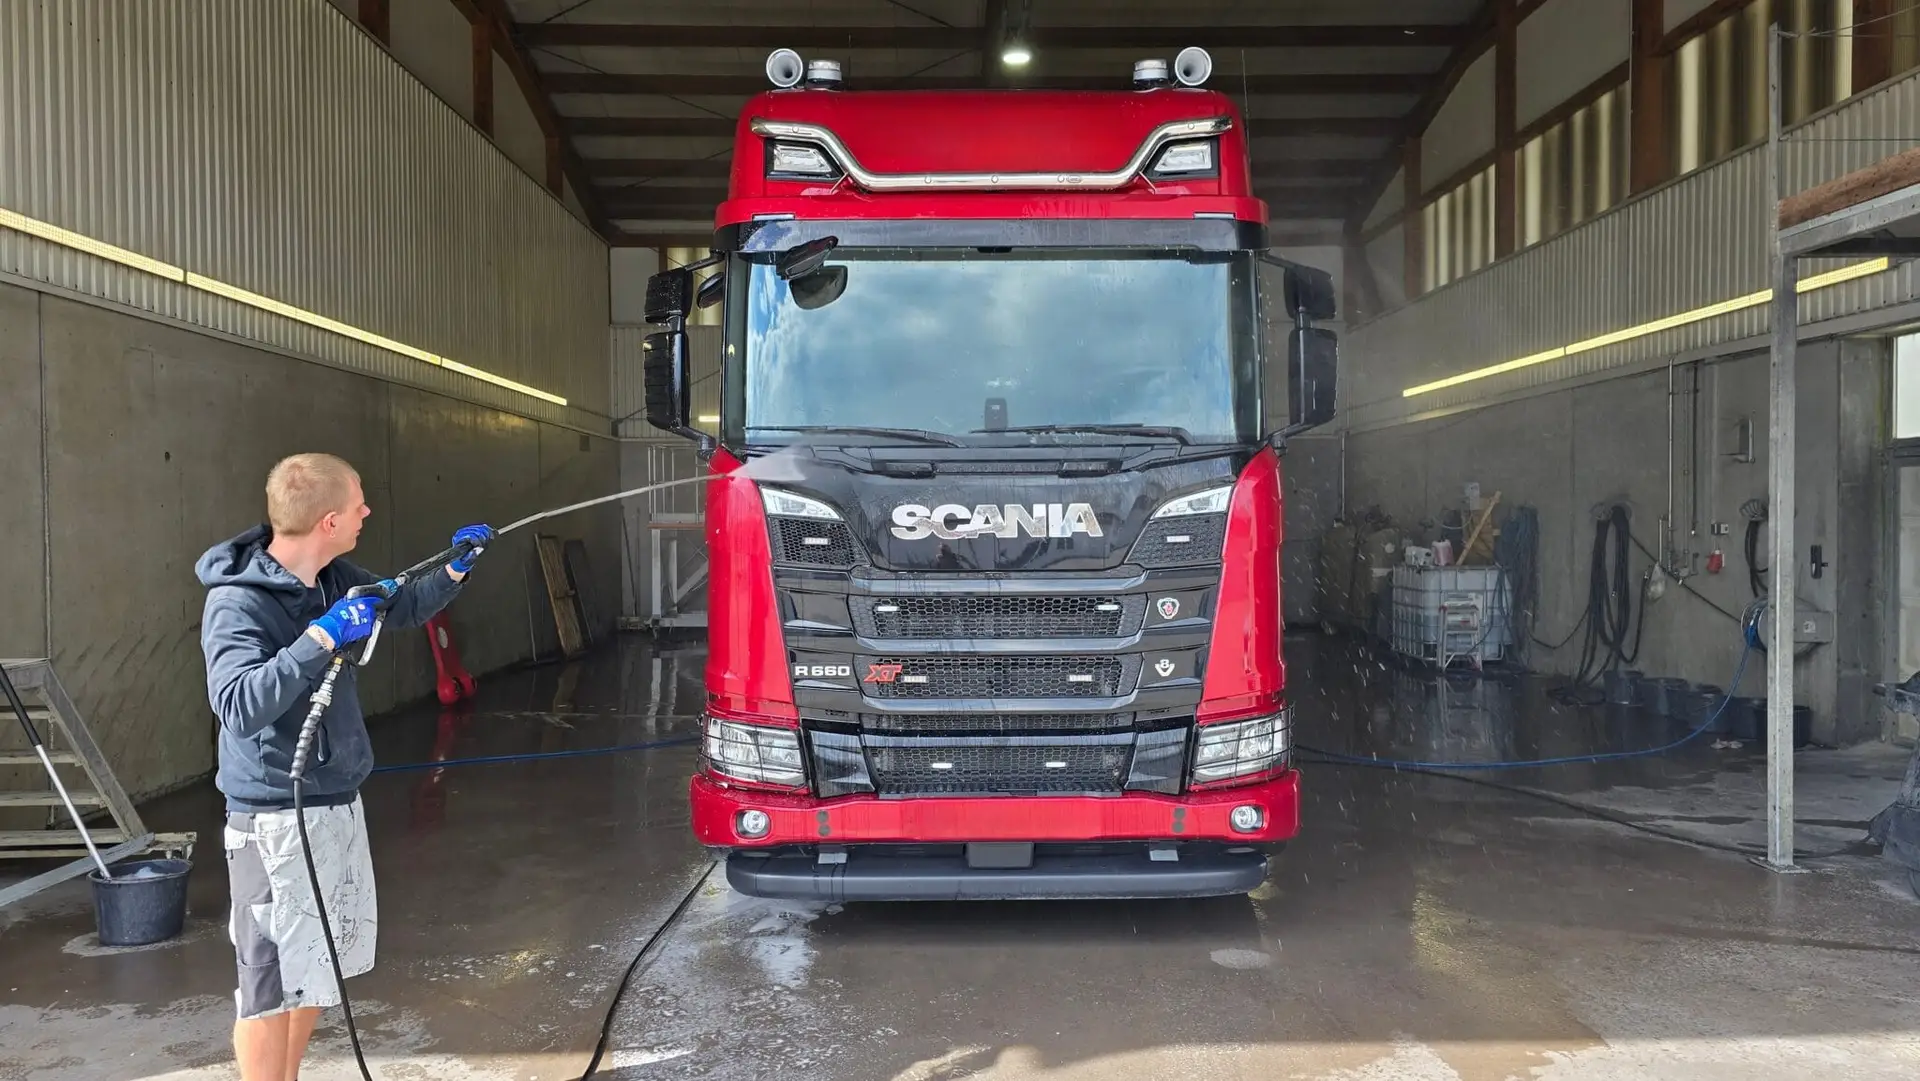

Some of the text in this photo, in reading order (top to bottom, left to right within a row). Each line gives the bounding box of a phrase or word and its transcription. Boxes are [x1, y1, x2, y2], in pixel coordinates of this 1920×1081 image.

[891, 503, 1104, 540] SCANIA
[795, 666, 850, 676] R 660
[863, 664, 903, 683] XT
